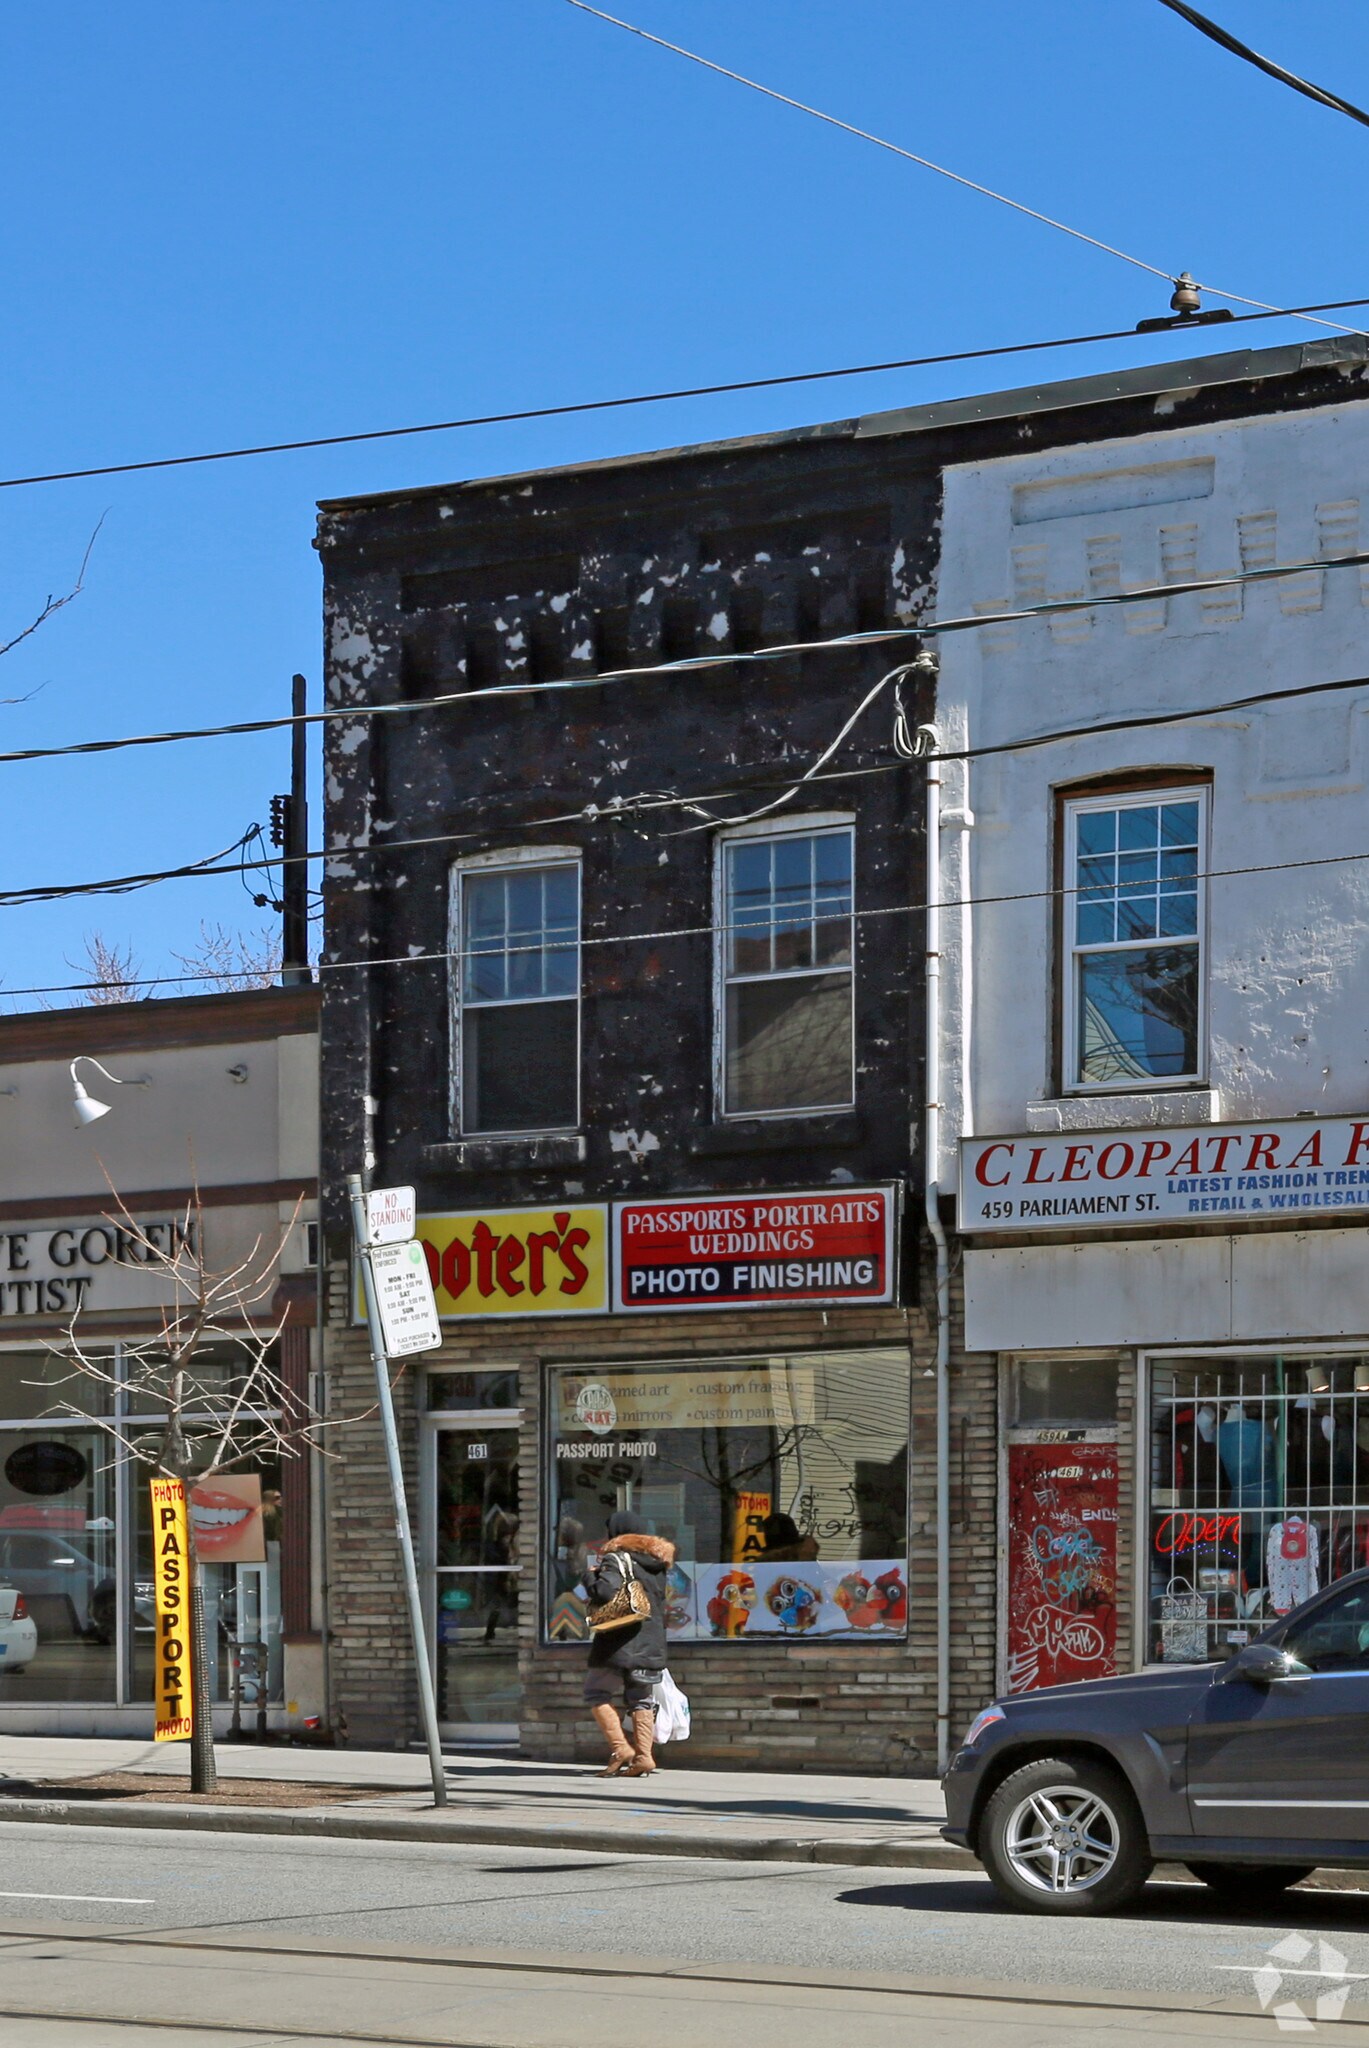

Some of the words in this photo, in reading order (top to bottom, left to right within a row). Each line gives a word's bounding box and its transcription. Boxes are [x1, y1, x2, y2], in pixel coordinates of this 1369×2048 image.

[975, 1130, 1323, 1187] CLEOPATRA
[1341, 1121, 1369, 1167] F
[1168, 1177, 1232, 1194] LATEST
[1237, 1172, 1318, 1190] FASHION
[385, 1193, 398, 1208] NO
[981, 1200, 1013, 1219] 459
[1020, 1194, 1130, 1217] PARLIAMENT
[1135, 1193, 1160, 1212] ST.
[1188, 1195, 1246, 1212] RETAIL
[1251, 1196, 1263, 1209] &
[1269, 1188, 1369, 1208] WHOLESAL
[370, 1207, 412, 1228] STANDING
[627, 1206, 746, 1235] PASSPORTS
[753, 1200, 881, 1231] PORTRAITS
[0, 1234, 29, 1271] E
[48, 1222, 195, 1268] GOREN
[689, 1229, 815, 1255] WEDDINGS
[388, 1275, 402, 1284] MON
[406, 1272, 416, 1281] FRI
[631, 1267, 721, 1295] PHOTO
[733, 1260, 873, 1290] FINISHING
[399, 1290, 411, 1299] SAT
[402, 1306, 414, 1315] SUN
[649, 1384, 670, 1397] art
[696, 1381, 745, 1396] custom
[623, 1410, 673, 1422] mirrors
[693, 1406, 744, 1421] custom
[469, 1444, 487, 1458] 461
[556, 1443, 615, 1459] PASSPORT
[619, 1441, 657, 1458] PHOTO
[1060, 1467, 1078, 1477] 461
[154, 1484, 185, 1502] PHOTO
[1155, 1511, 1241, 1553] Open
[160, 1507, 183, 1718] PASSPORT
[156, 1717, 191, 1739] PHOTO
